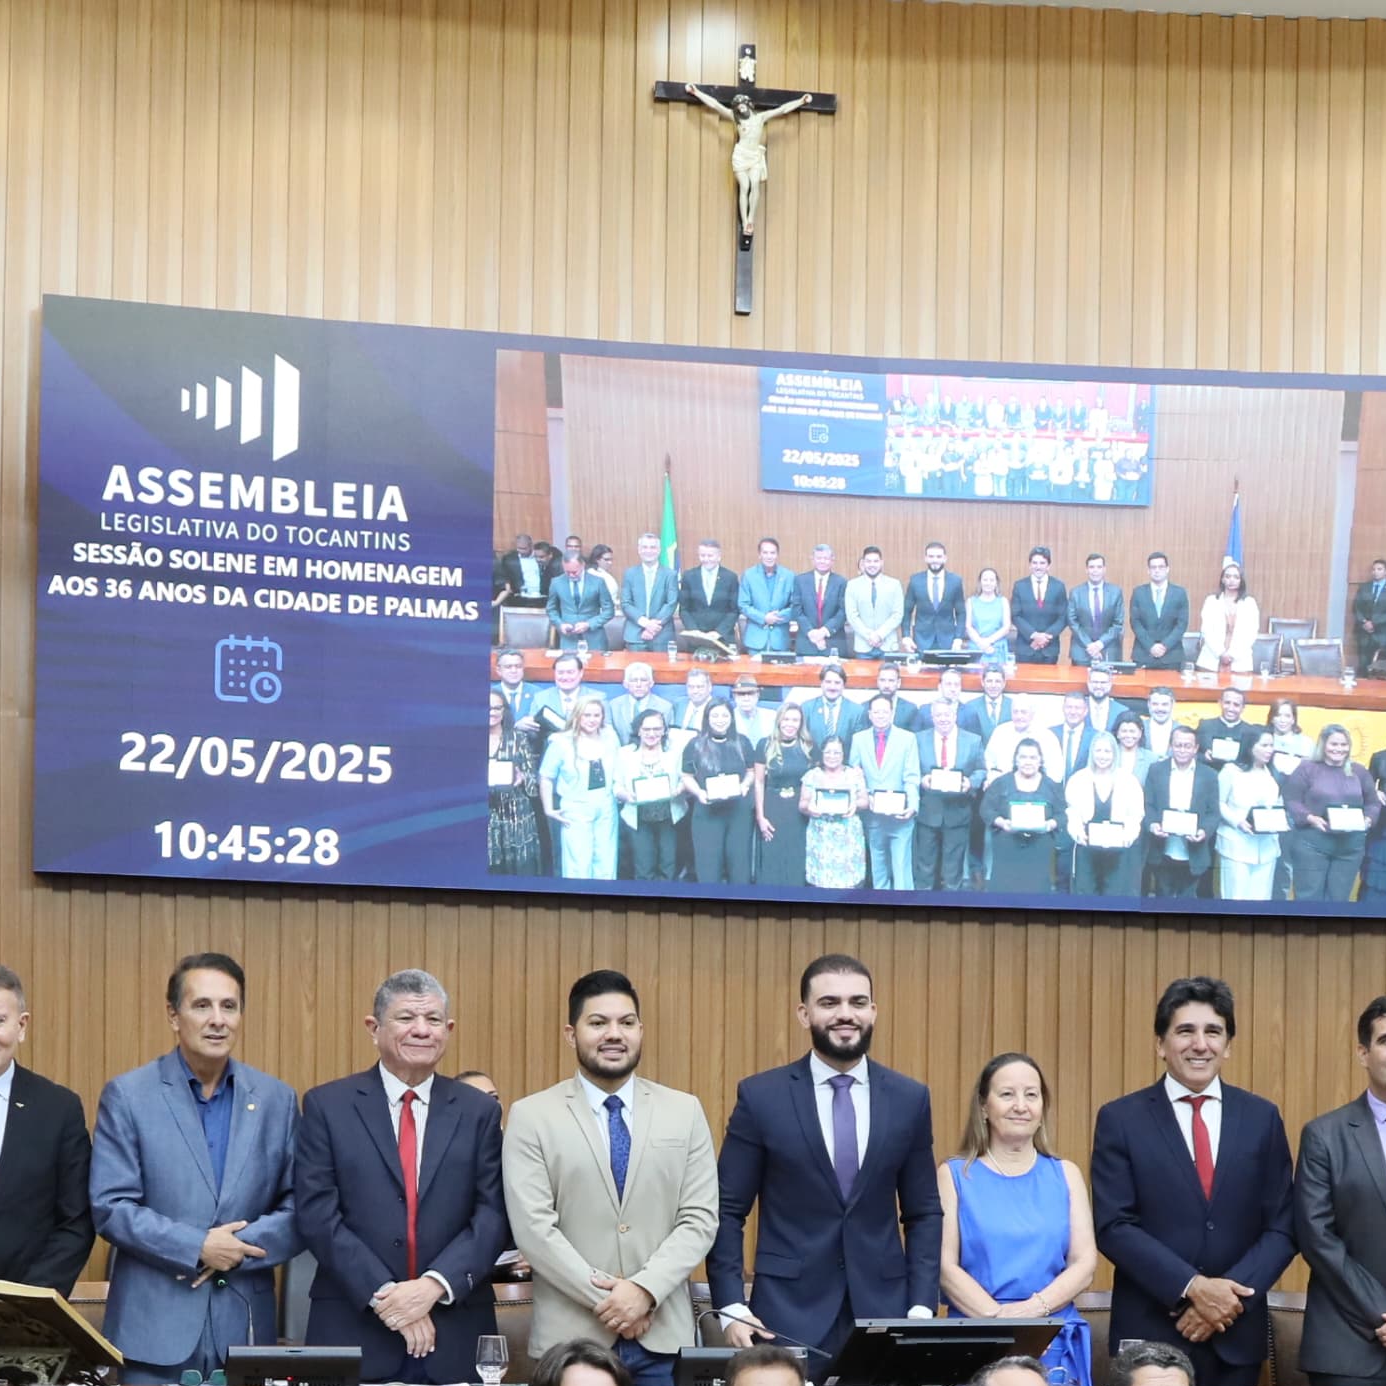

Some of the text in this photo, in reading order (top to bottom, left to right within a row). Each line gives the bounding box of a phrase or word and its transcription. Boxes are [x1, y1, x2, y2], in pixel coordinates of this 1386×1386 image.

[102, 464, 409, 523] ASSEMBLEIA
[100, 511, 411, 552] LEGISLATIVA DO TOCANTINS
[73, 541, 463, 588] SESSÃO SOLENE EM HOMENAGEM
[47, 574, 480, 621] AOS 36 ANOS DA CIDADE DE PALMAS
[119, 731, 393, 785] 22/05/2025
[154, 820, 340, 867] 10:45:28
